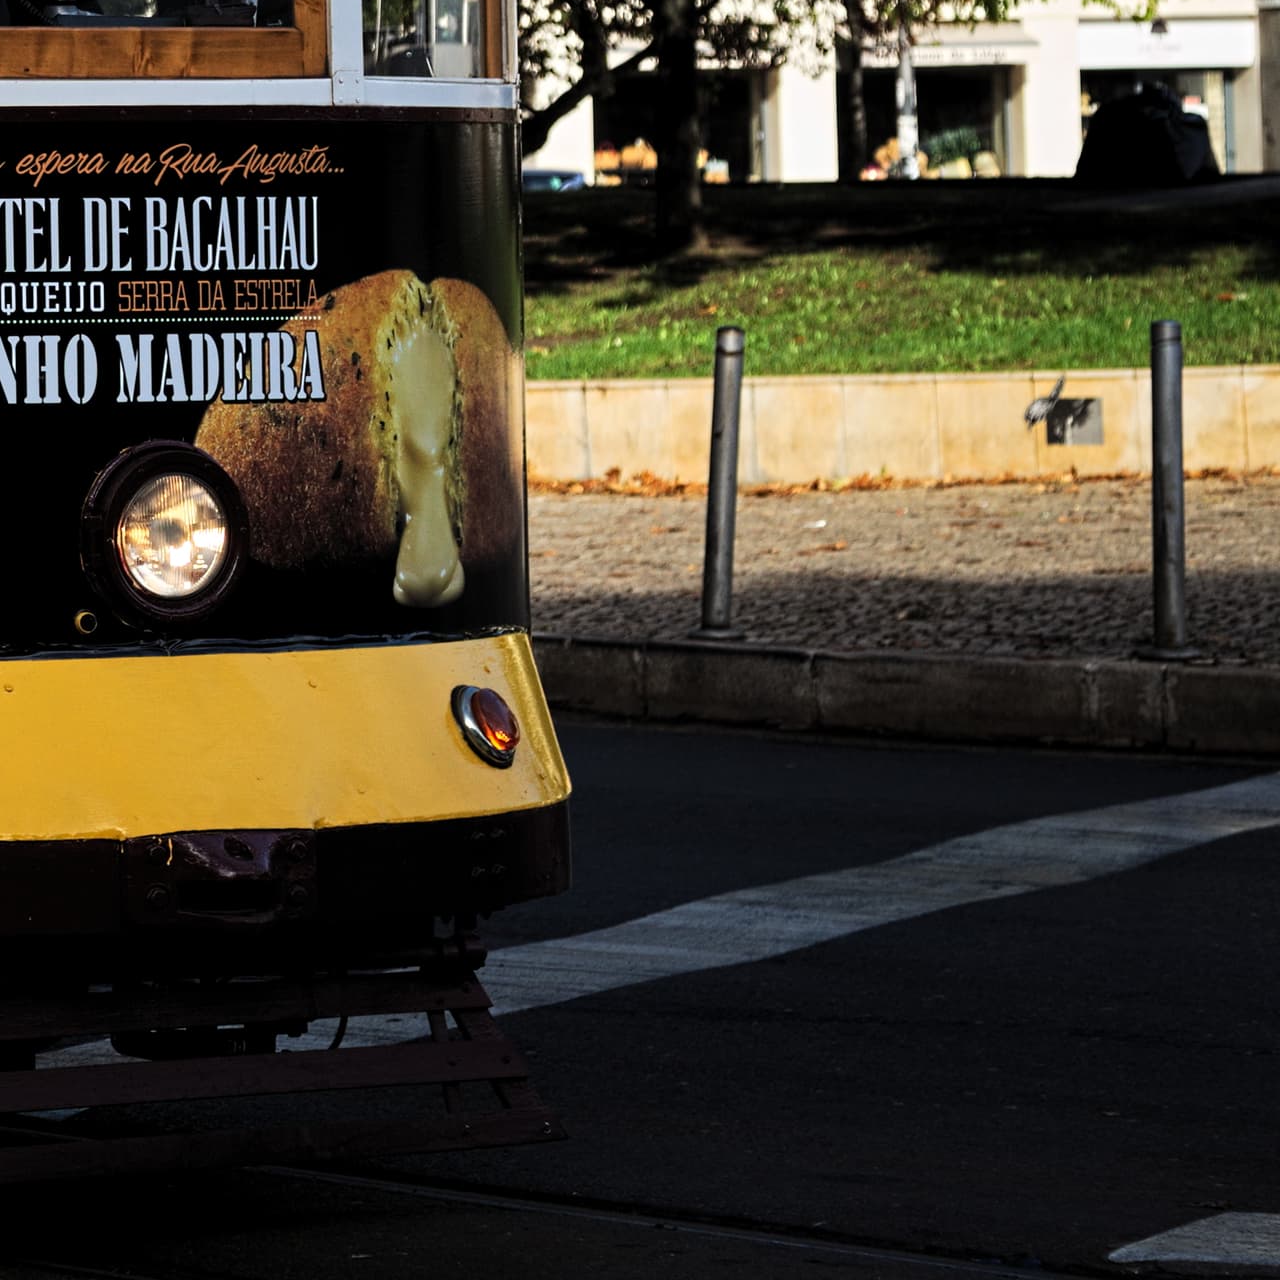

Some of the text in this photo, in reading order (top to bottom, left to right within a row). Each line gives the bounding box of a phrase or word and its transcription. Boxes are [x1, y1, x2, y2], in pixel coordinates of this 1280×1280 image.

[15, 150, 111, 187] espera
[115, 152, 157, 175] na
[153, 143, 223, 186] Rua
[82, 196, 133, 272] DE
[143, 195, 319, 272] BACALHAU
[0, 280, 106, 316] QUEIJO
[118, 279, 189, 312] SERRA
[197, 279, 227, 311] DA
[233, 278, 320, 311] ESTRELA
[115, 330, 327, 403] MADEIRA
